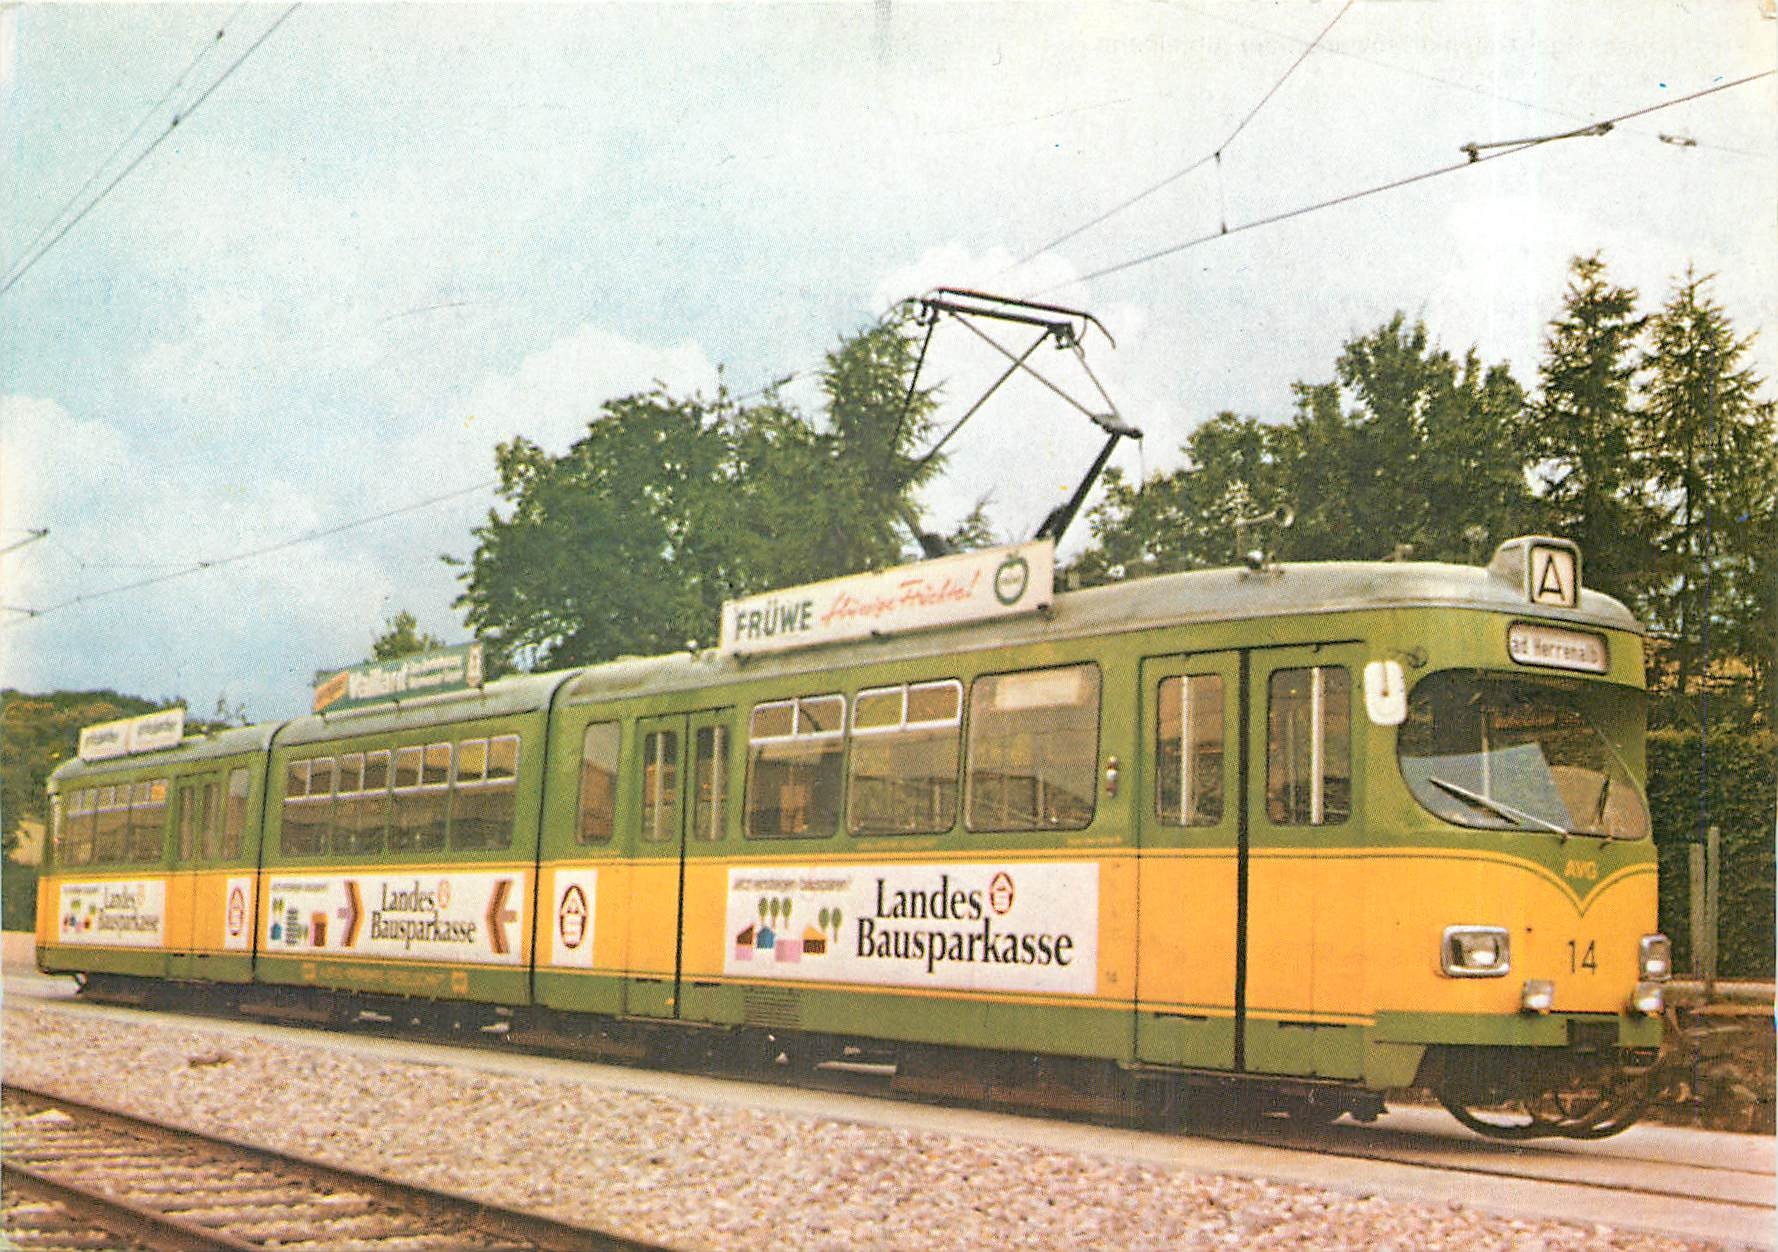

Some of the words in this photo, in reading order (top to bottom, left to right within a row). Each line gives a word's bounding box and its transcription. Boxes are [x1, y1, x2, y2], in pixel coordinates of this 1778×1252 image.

[1538, 553, 1568, 601] A
[735, 598, 813, 641] FRÜWE
[381, 880, 435, 912] Landes
[876, 874, 984, 920] Landes
[371, 909, 476, 950] Bausparkasse
[856, 917, 1074, 975] Bausparkasse
[1568, 939, 1598, 976] 14
